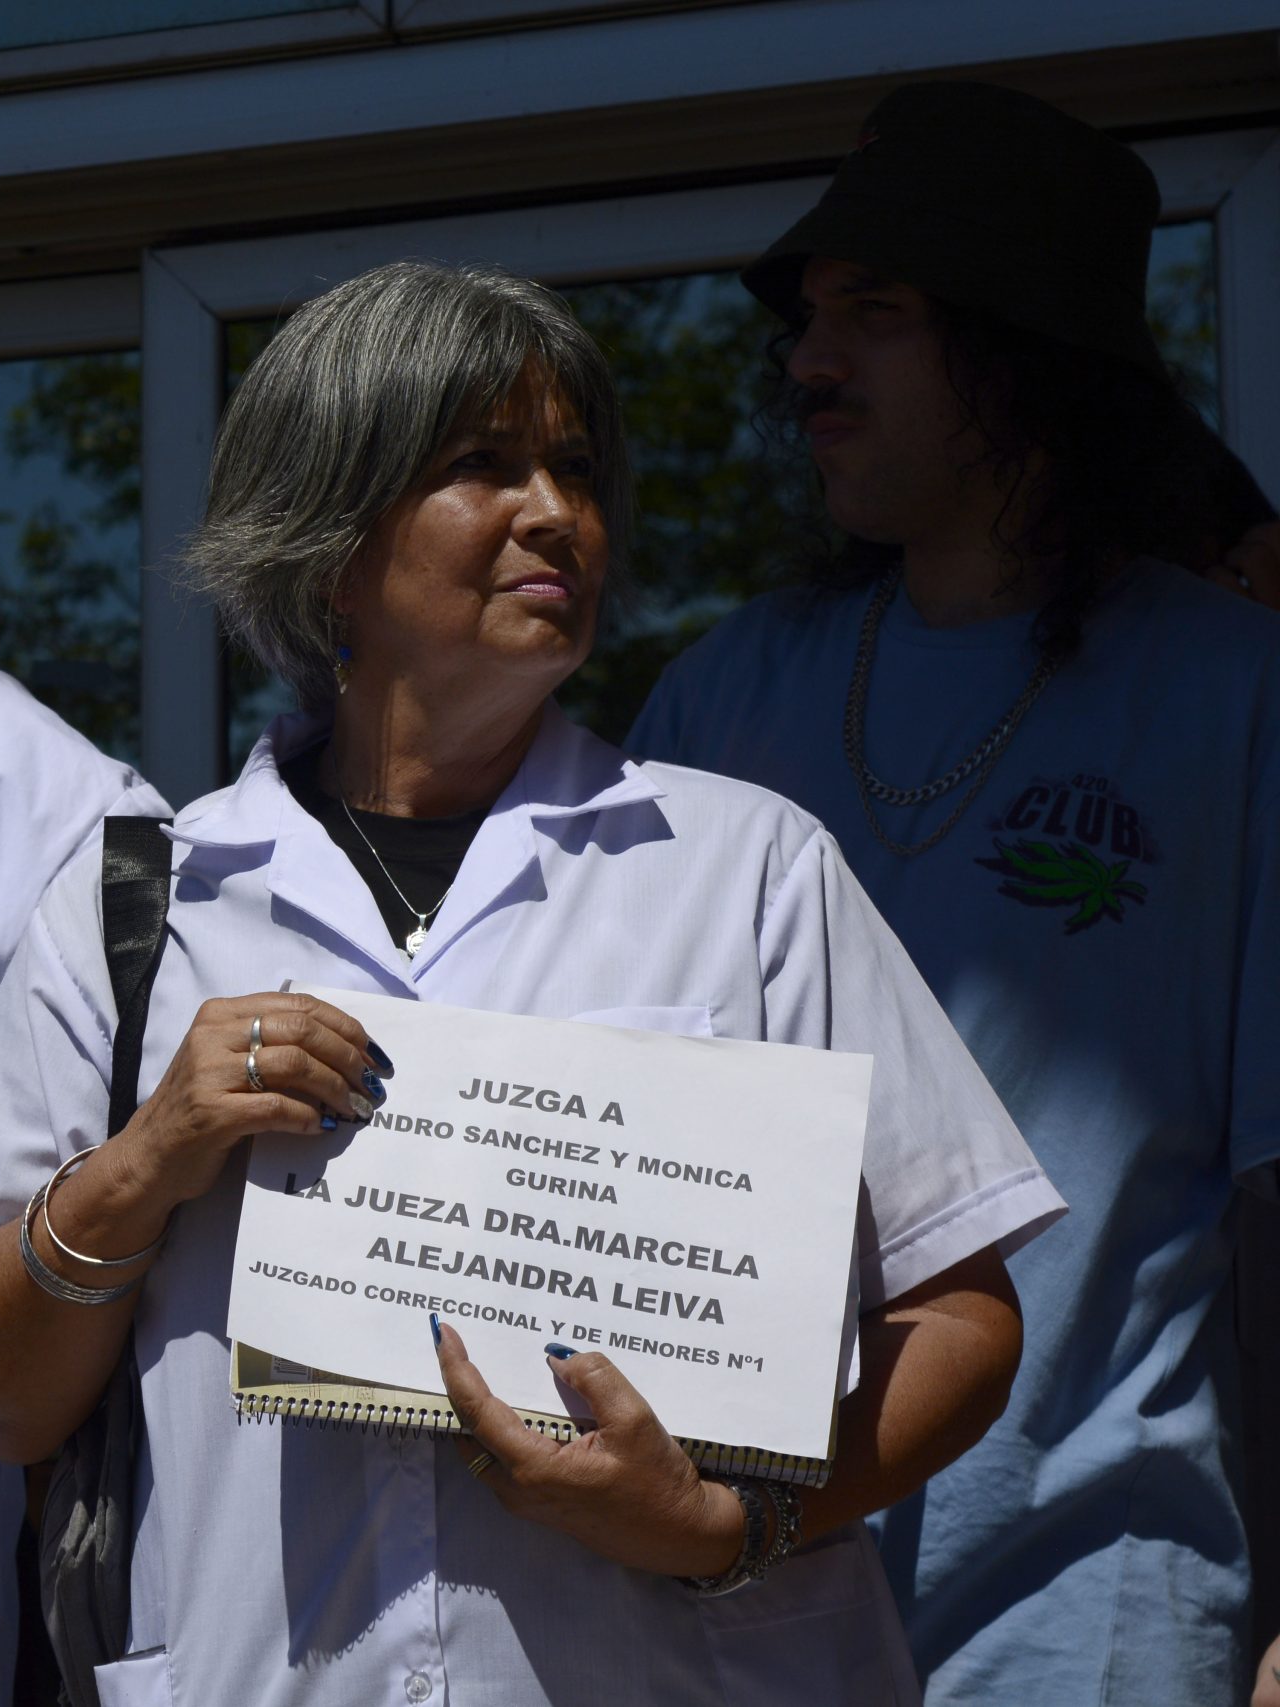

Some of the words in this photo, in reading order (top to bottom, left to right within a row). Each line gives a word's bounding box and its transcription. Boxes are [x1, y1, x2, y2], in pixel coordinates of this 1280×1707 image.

[1072, 773, 1108, 793] 420
[1006, 786, 1141, 858] CLUB
[458, 1078, 587, 1119] JUZGA
[598, 1101, 625, 1127] A
[463, 1125, 601, 1165] SANCHEZ
[610, 1149, 629, 1169] Y
[637, 1155, 753, 1193] MONICA
[506, 1168, 618, 1205] GURINA
[284, 1172, 332, 1203] LA
[343, 1185, 470, 1228] JUEZA
[483, 1207, 759, 1280] DRA.MARCELA
[248, 1260, 357, 1295] JUZGADO
[364, 1284, 542, 1332] CORRECCIONAL
[550, 1319, 566, 1336] Y
[572, 1324, 603, 1344] DE
[608, 1331, 720, 1366] MENORES
[366, 1236, 599, 1303] ALEJANDRA
[611, 1282, 725, 1325] LEIVA
